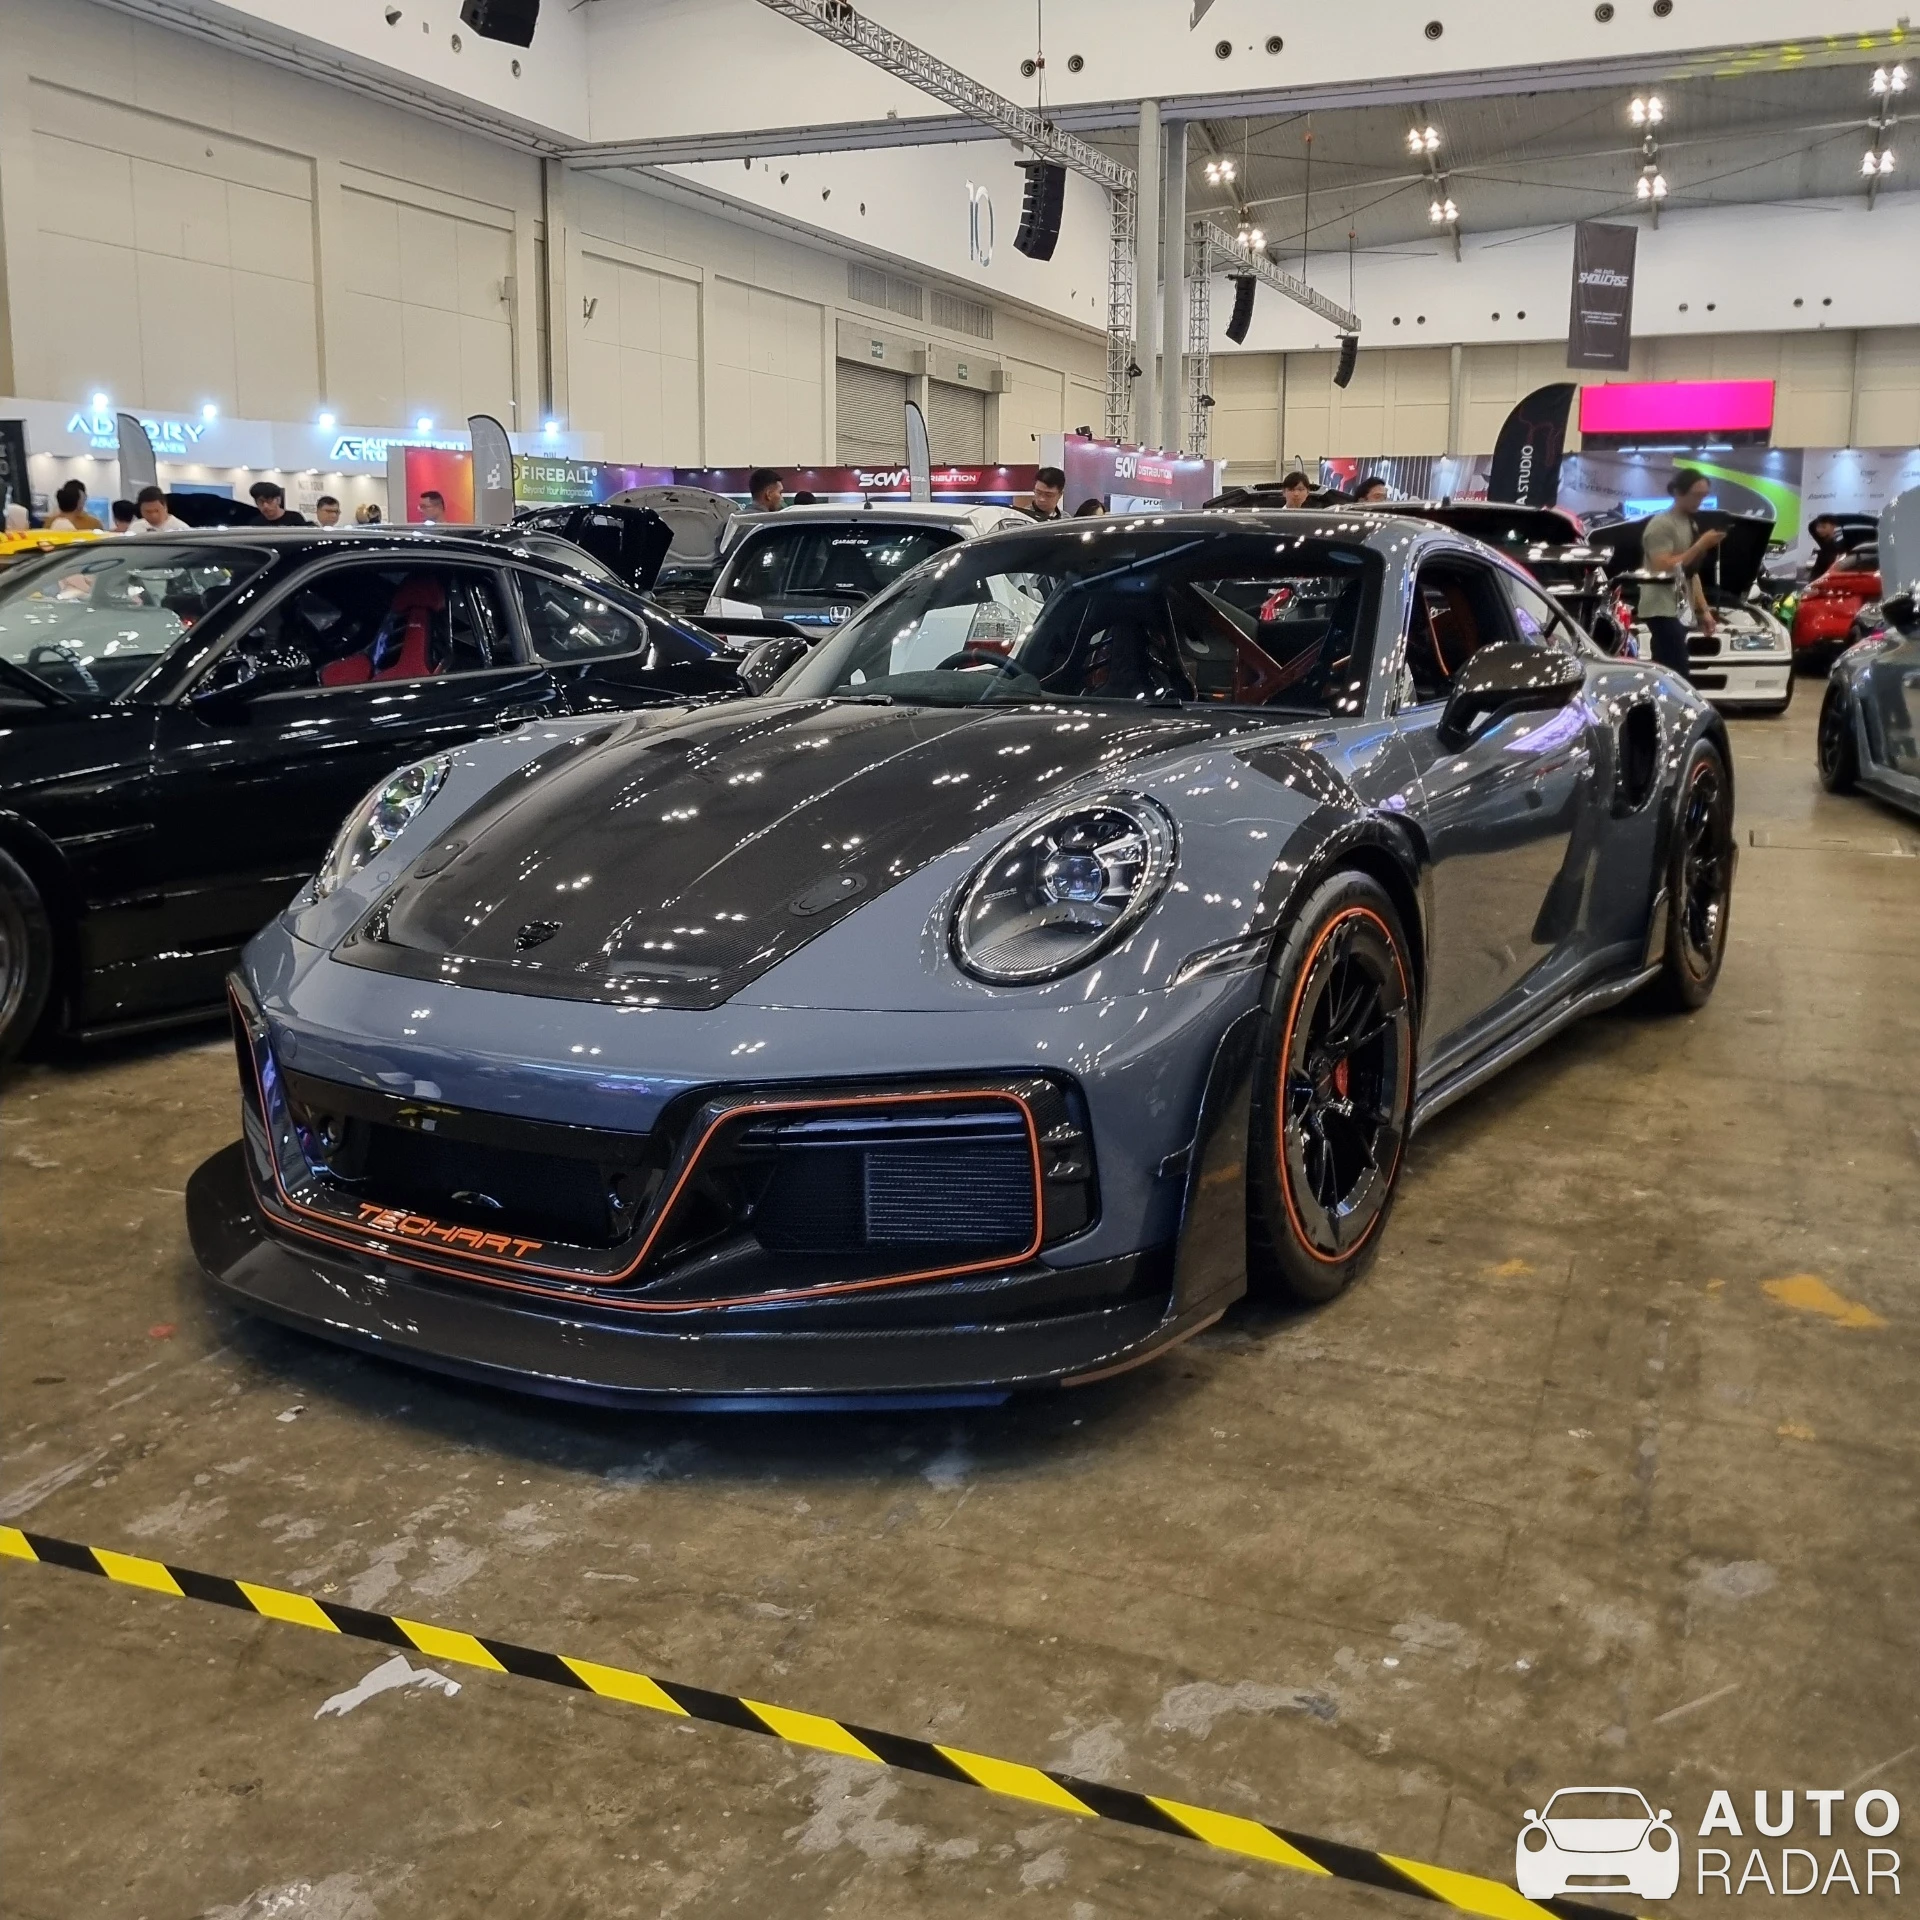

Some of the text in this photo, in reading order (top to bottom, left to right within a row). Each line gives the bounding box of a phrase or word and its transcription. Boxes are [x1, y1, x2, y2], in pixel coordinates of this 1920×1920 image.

[521, 465, 593, 484] FIREBALL
[1138, 465, 1173, 479] DISTRIBUTION
[1517, 445, 1534, 493] STUDIO
[858, 471, 903, 487] SCW
[523, 484, 545, 496] Beyond
[546, 485, 559, 496] Your
[358, 1203, 543, 1257] TECHART
